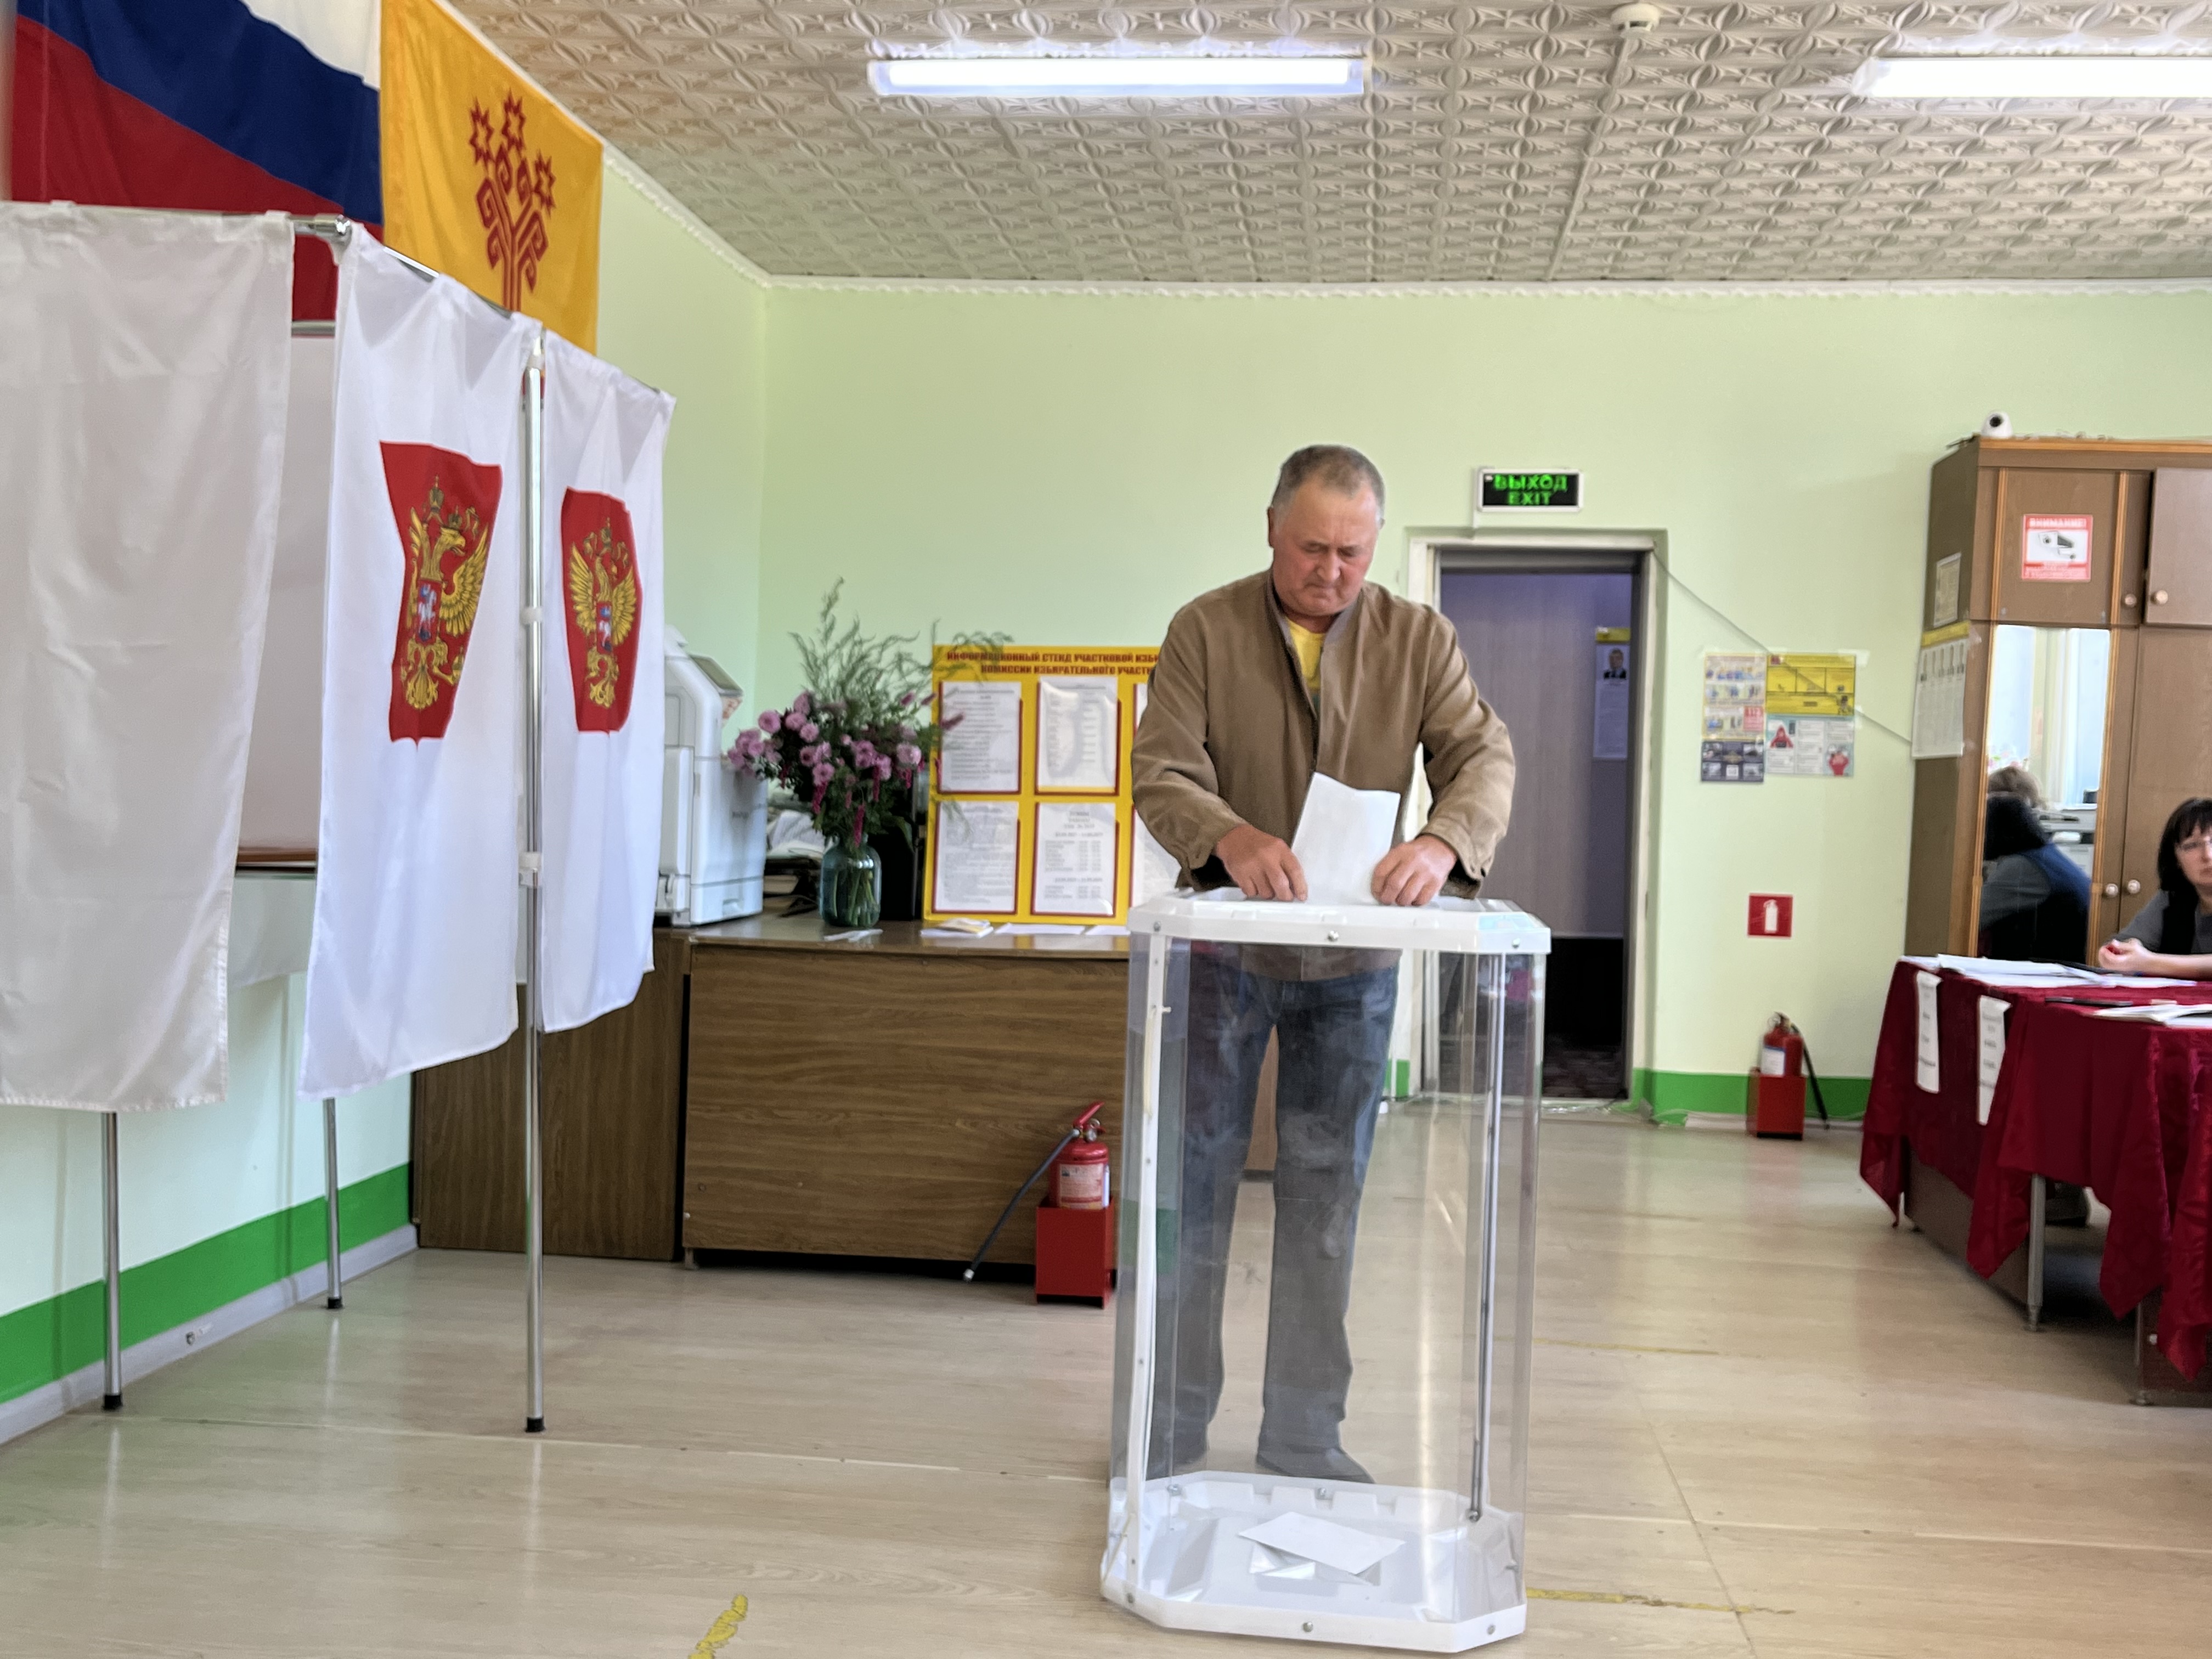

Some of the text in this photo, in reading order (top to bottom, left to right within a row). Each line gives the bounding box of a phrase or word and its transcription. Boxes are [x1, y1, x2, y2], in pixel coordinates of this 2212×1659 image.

[1493, 473, 1568, 492] ВЫХОД
[1508, 490, 1551, 505] EXIT
[1042, 653, 1072, 663] СТЕНД
[1074, 652, 1133, 663] УЧАСТКОВОЙ
[981, 665, 1032, 674] КОМИССИИ
[1034, 665, 1116, 675] ИЗБИРАТЕЛЬНОГО
